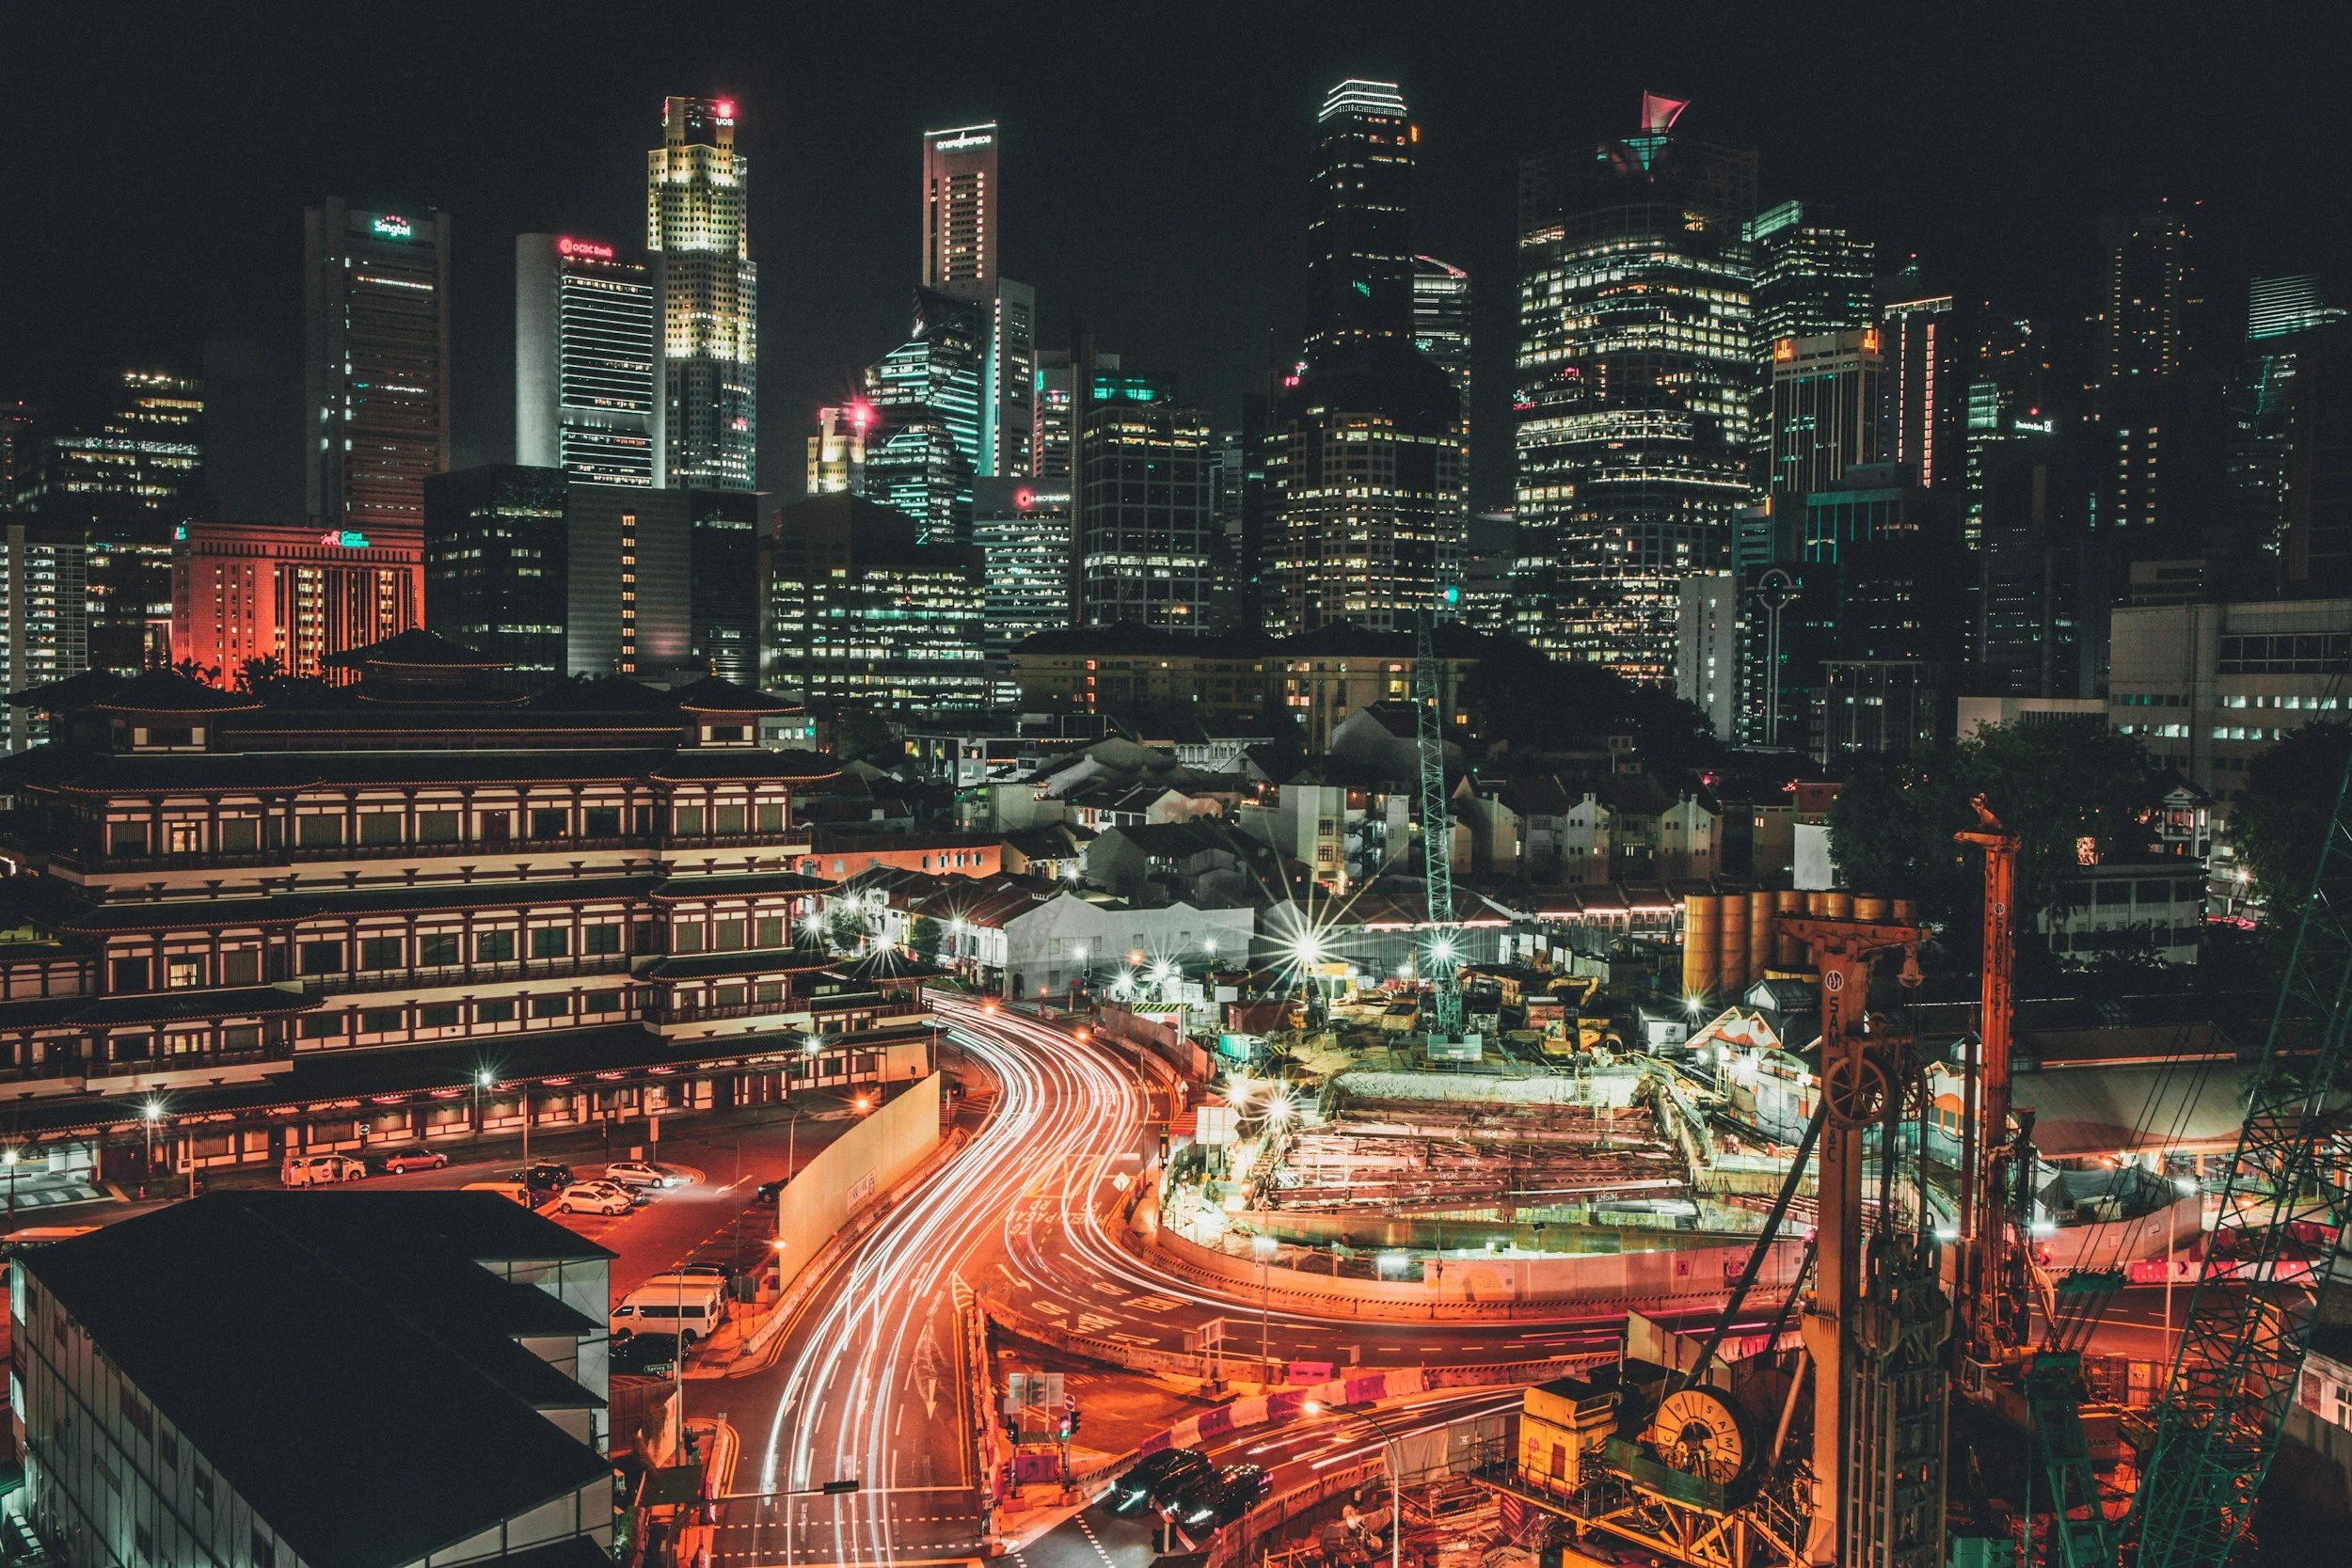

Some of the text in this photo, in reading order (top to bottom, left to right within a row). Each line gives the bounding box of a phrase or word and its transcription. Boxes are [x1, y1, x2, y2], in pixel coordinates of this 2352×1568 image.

[716, 118, 734, 126] UOB
[374, 220, 410, 236] Singtel
[572, 243, 612, 257] OCBC Bank
[2015, 420, 2043, 431] Deutsche Bank
[341, 531, 362, 540] Great
[341, 539, 369, 547] Eastern
[1029, 1199, 1051, 1211] RD
[1005, 1211, 1058, 1224] PAGAR
[1009, 1223, 1028, 1236] TG
